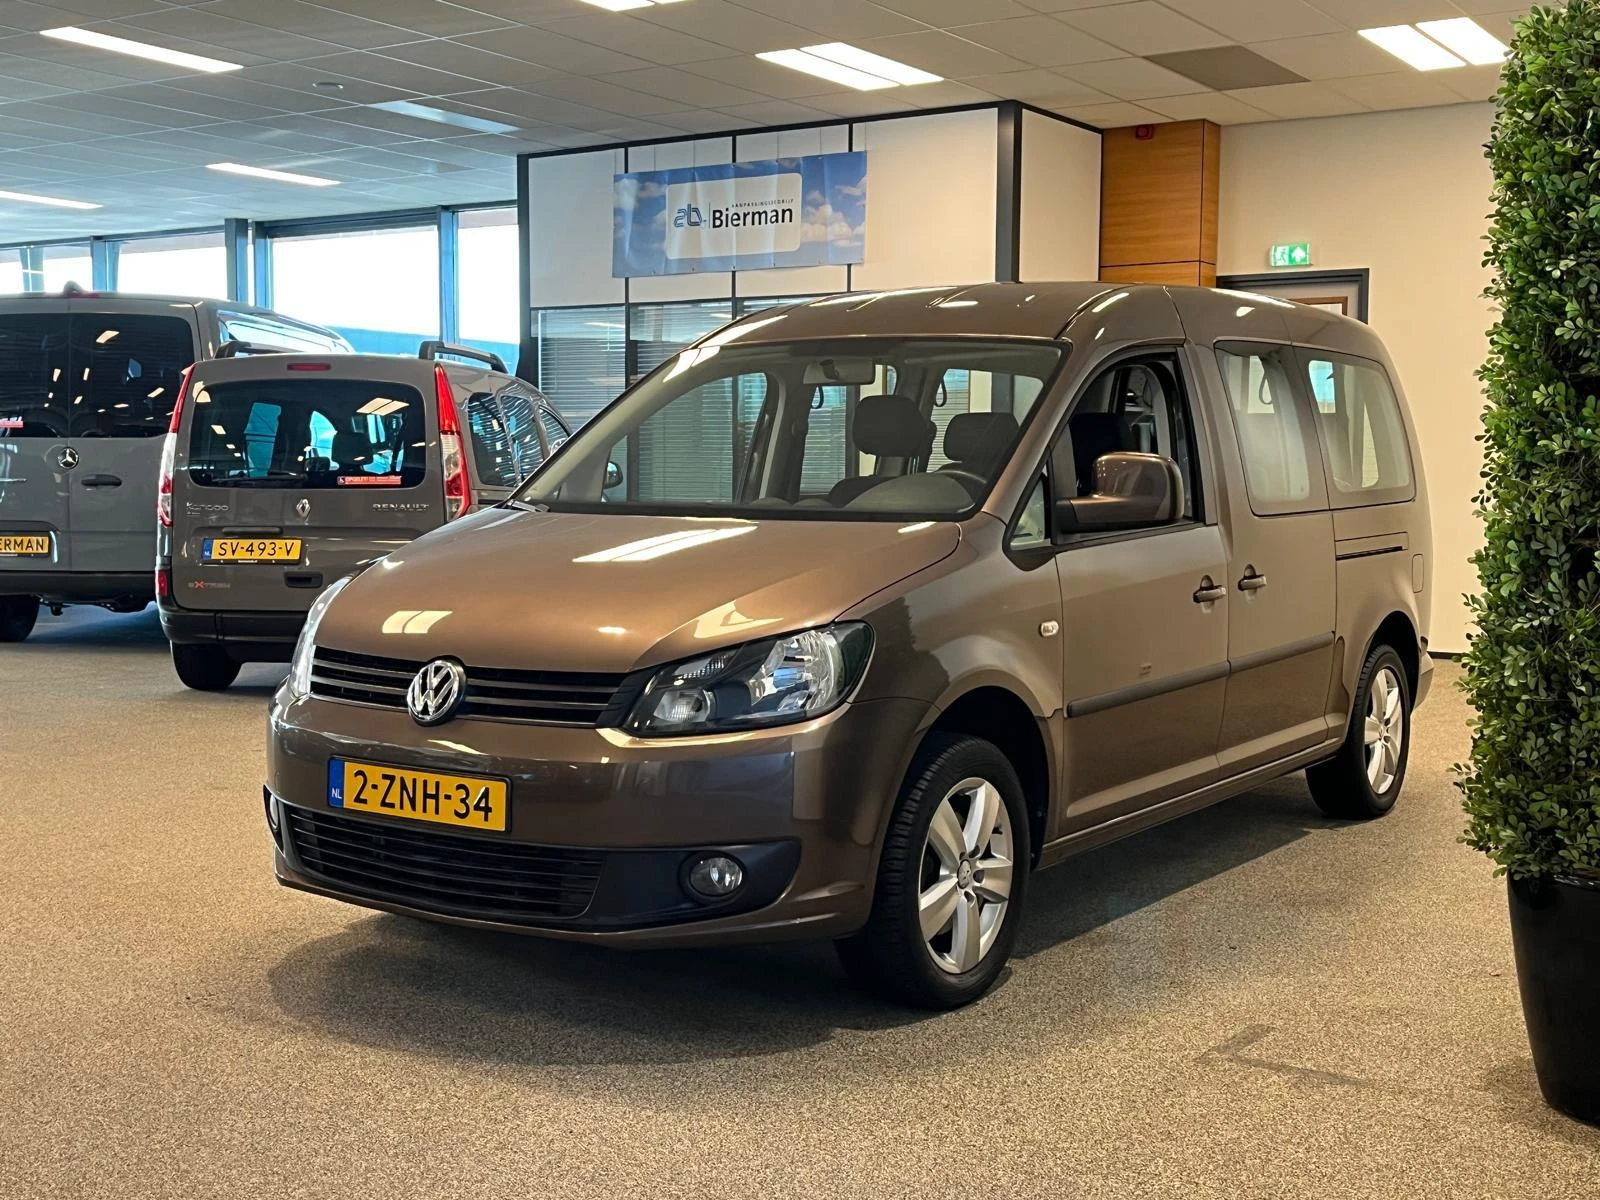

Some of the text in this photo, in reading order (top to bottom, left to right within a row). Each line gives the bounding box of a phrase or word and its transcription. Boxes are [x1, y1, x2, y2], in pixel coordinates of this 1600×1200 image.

[711, 207, 793, 229] Bierman
[372, 503, 430, 512] RENAULT
[218, 542, 295, 557] SV-493-V
[331, 769, 493, 822] NL 2-ZNH-34
